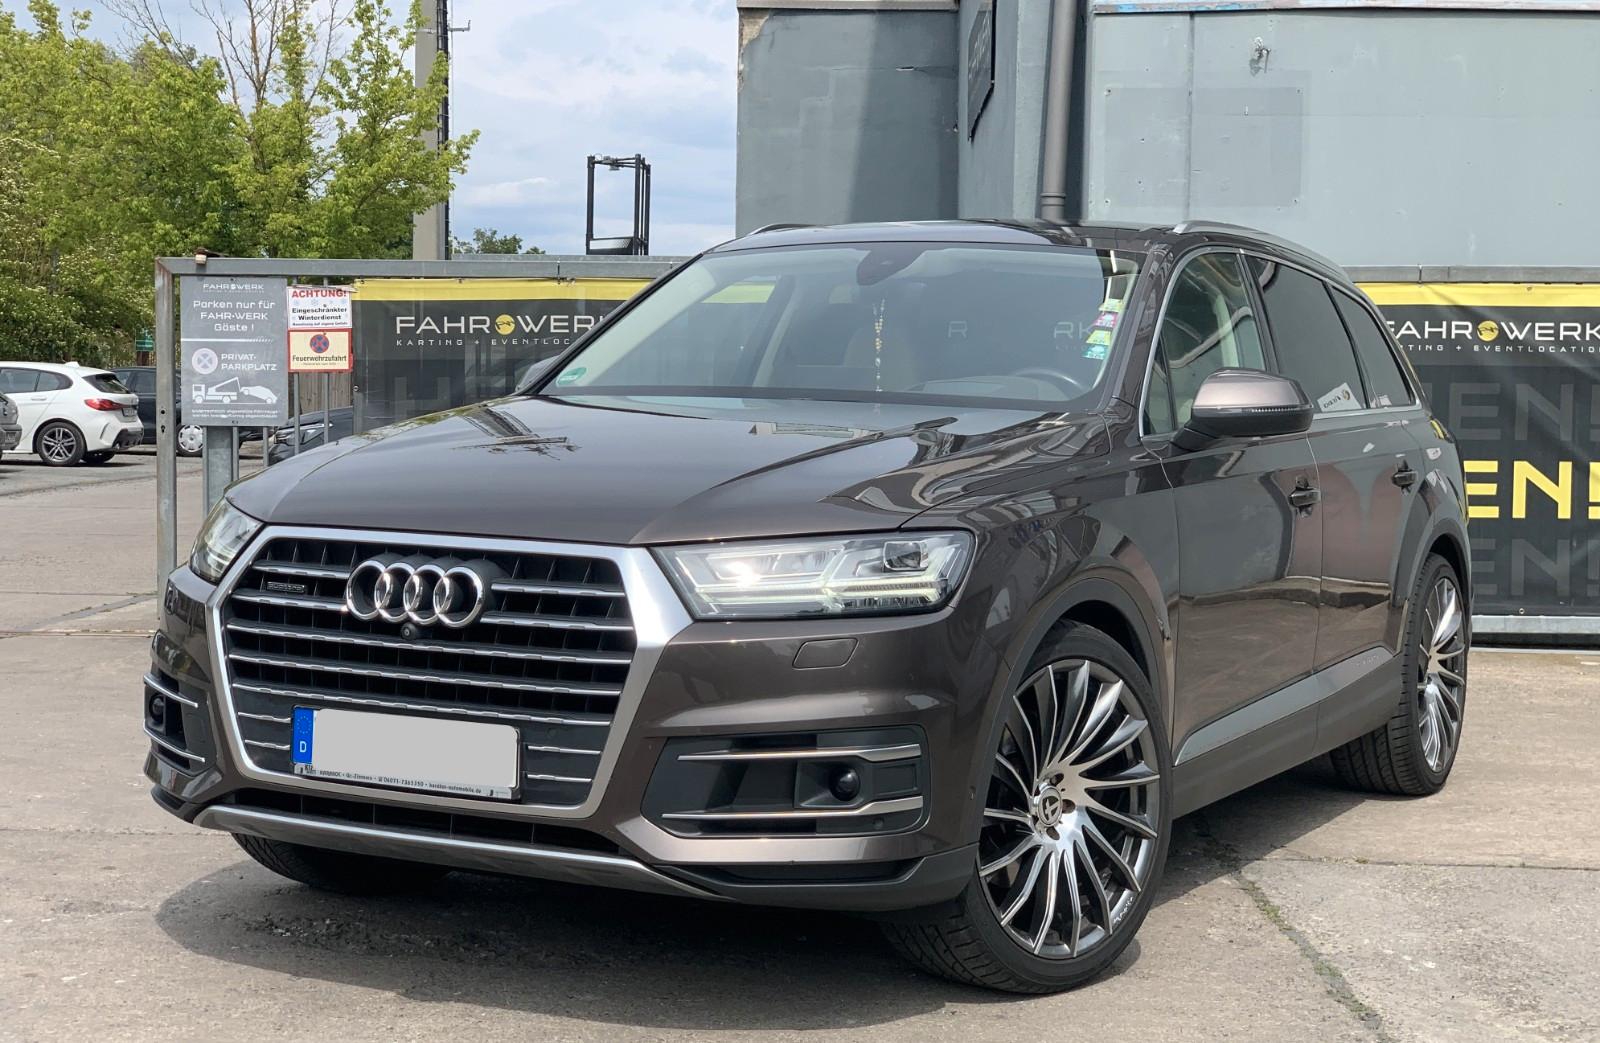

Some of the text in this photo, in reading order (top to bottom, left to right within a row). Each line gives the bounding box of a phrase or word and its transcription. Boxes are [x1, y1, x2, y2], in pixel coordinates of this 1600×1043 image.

[292, 289, 347, 298] ACHTUNG!
[193, 300, 276, 309] Parken nur für
[214, 323, 248, 331] Gäste
[516, 315, 604, 333] WER
[1474, 345, 1600, 353] EVENTLOCATIO
[1424, 382, 1600, 441] EN!
[299, 740, 307, 753] D
